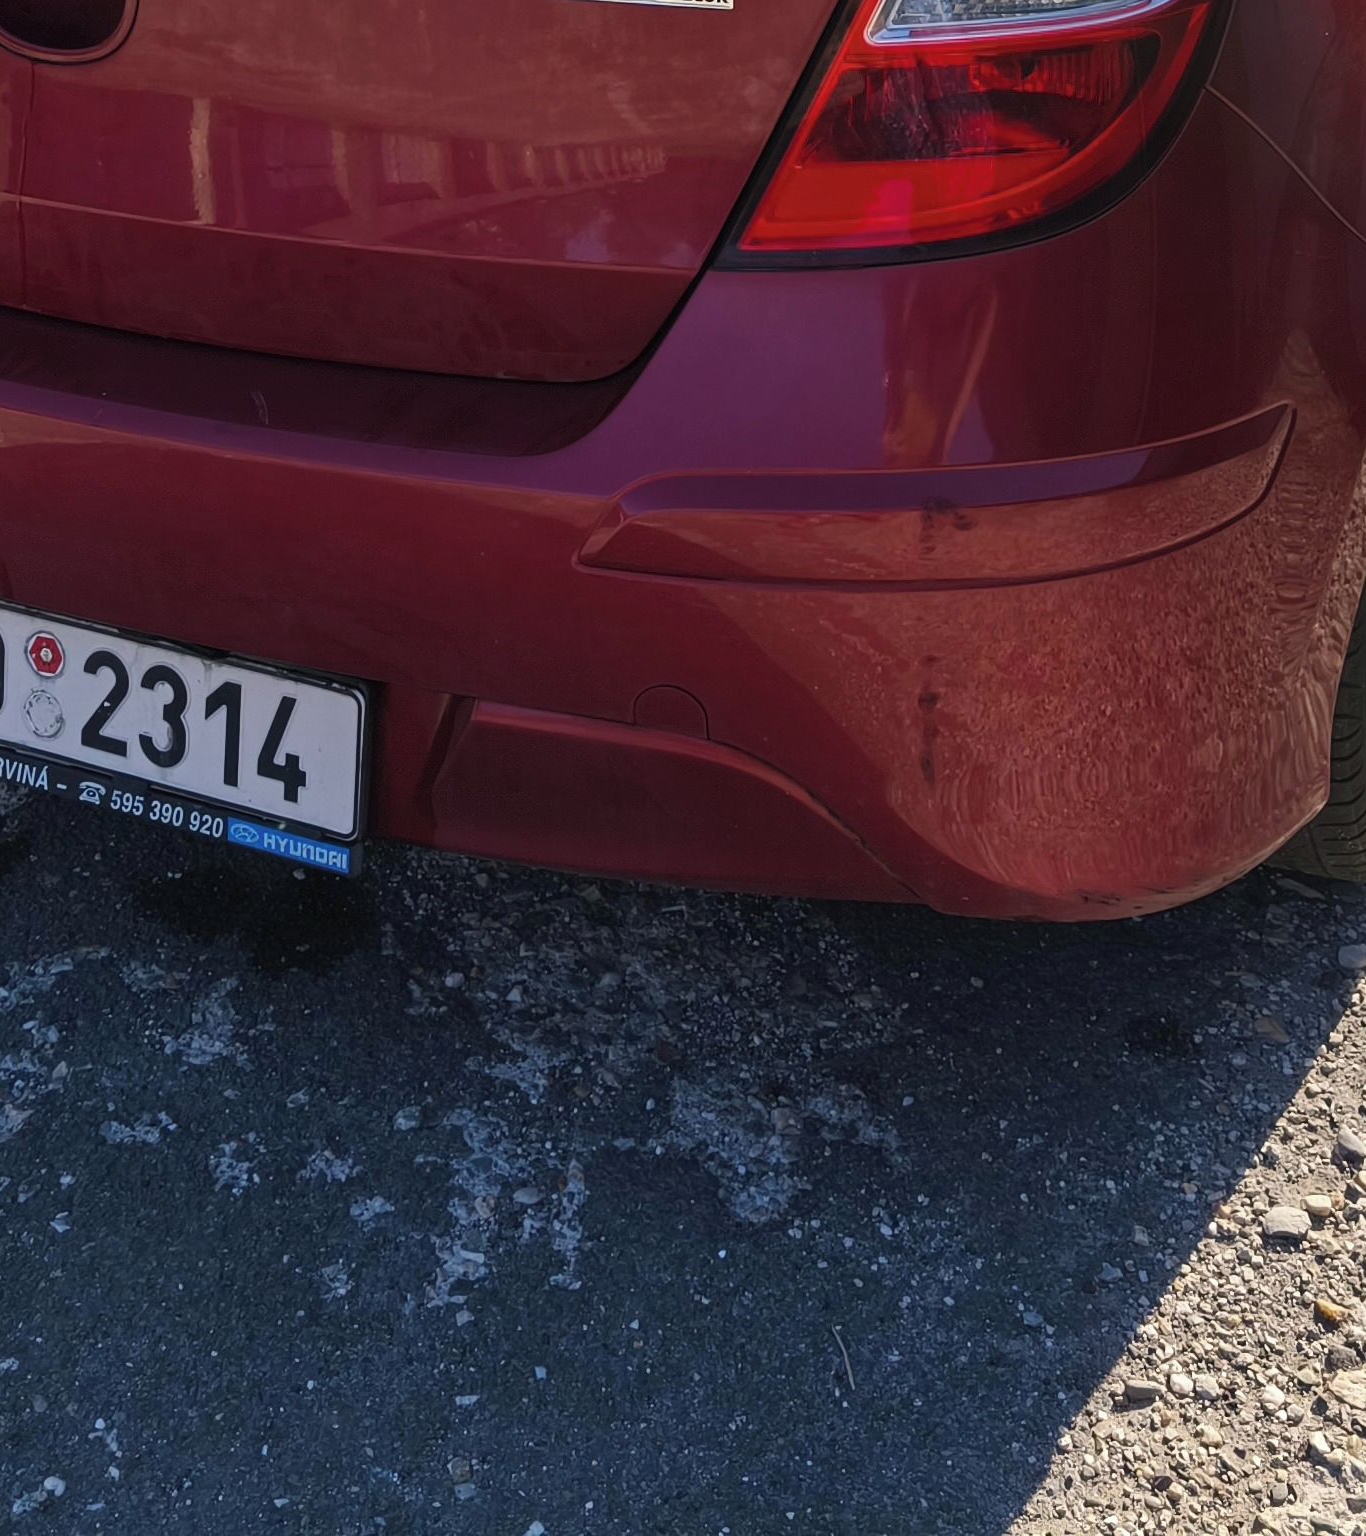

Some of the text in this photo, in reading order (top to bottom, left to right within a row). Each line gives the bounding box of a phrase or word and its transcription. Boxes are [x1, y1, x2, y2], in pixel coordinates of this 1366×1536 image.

[81, 650, 307, 804] 2314
[110, 790, 144, 816] 595
[149, 800, 183, 827] 390
[189, 811, 223, 838] 920
[263, 832, 348, 869] HYUNDAI
